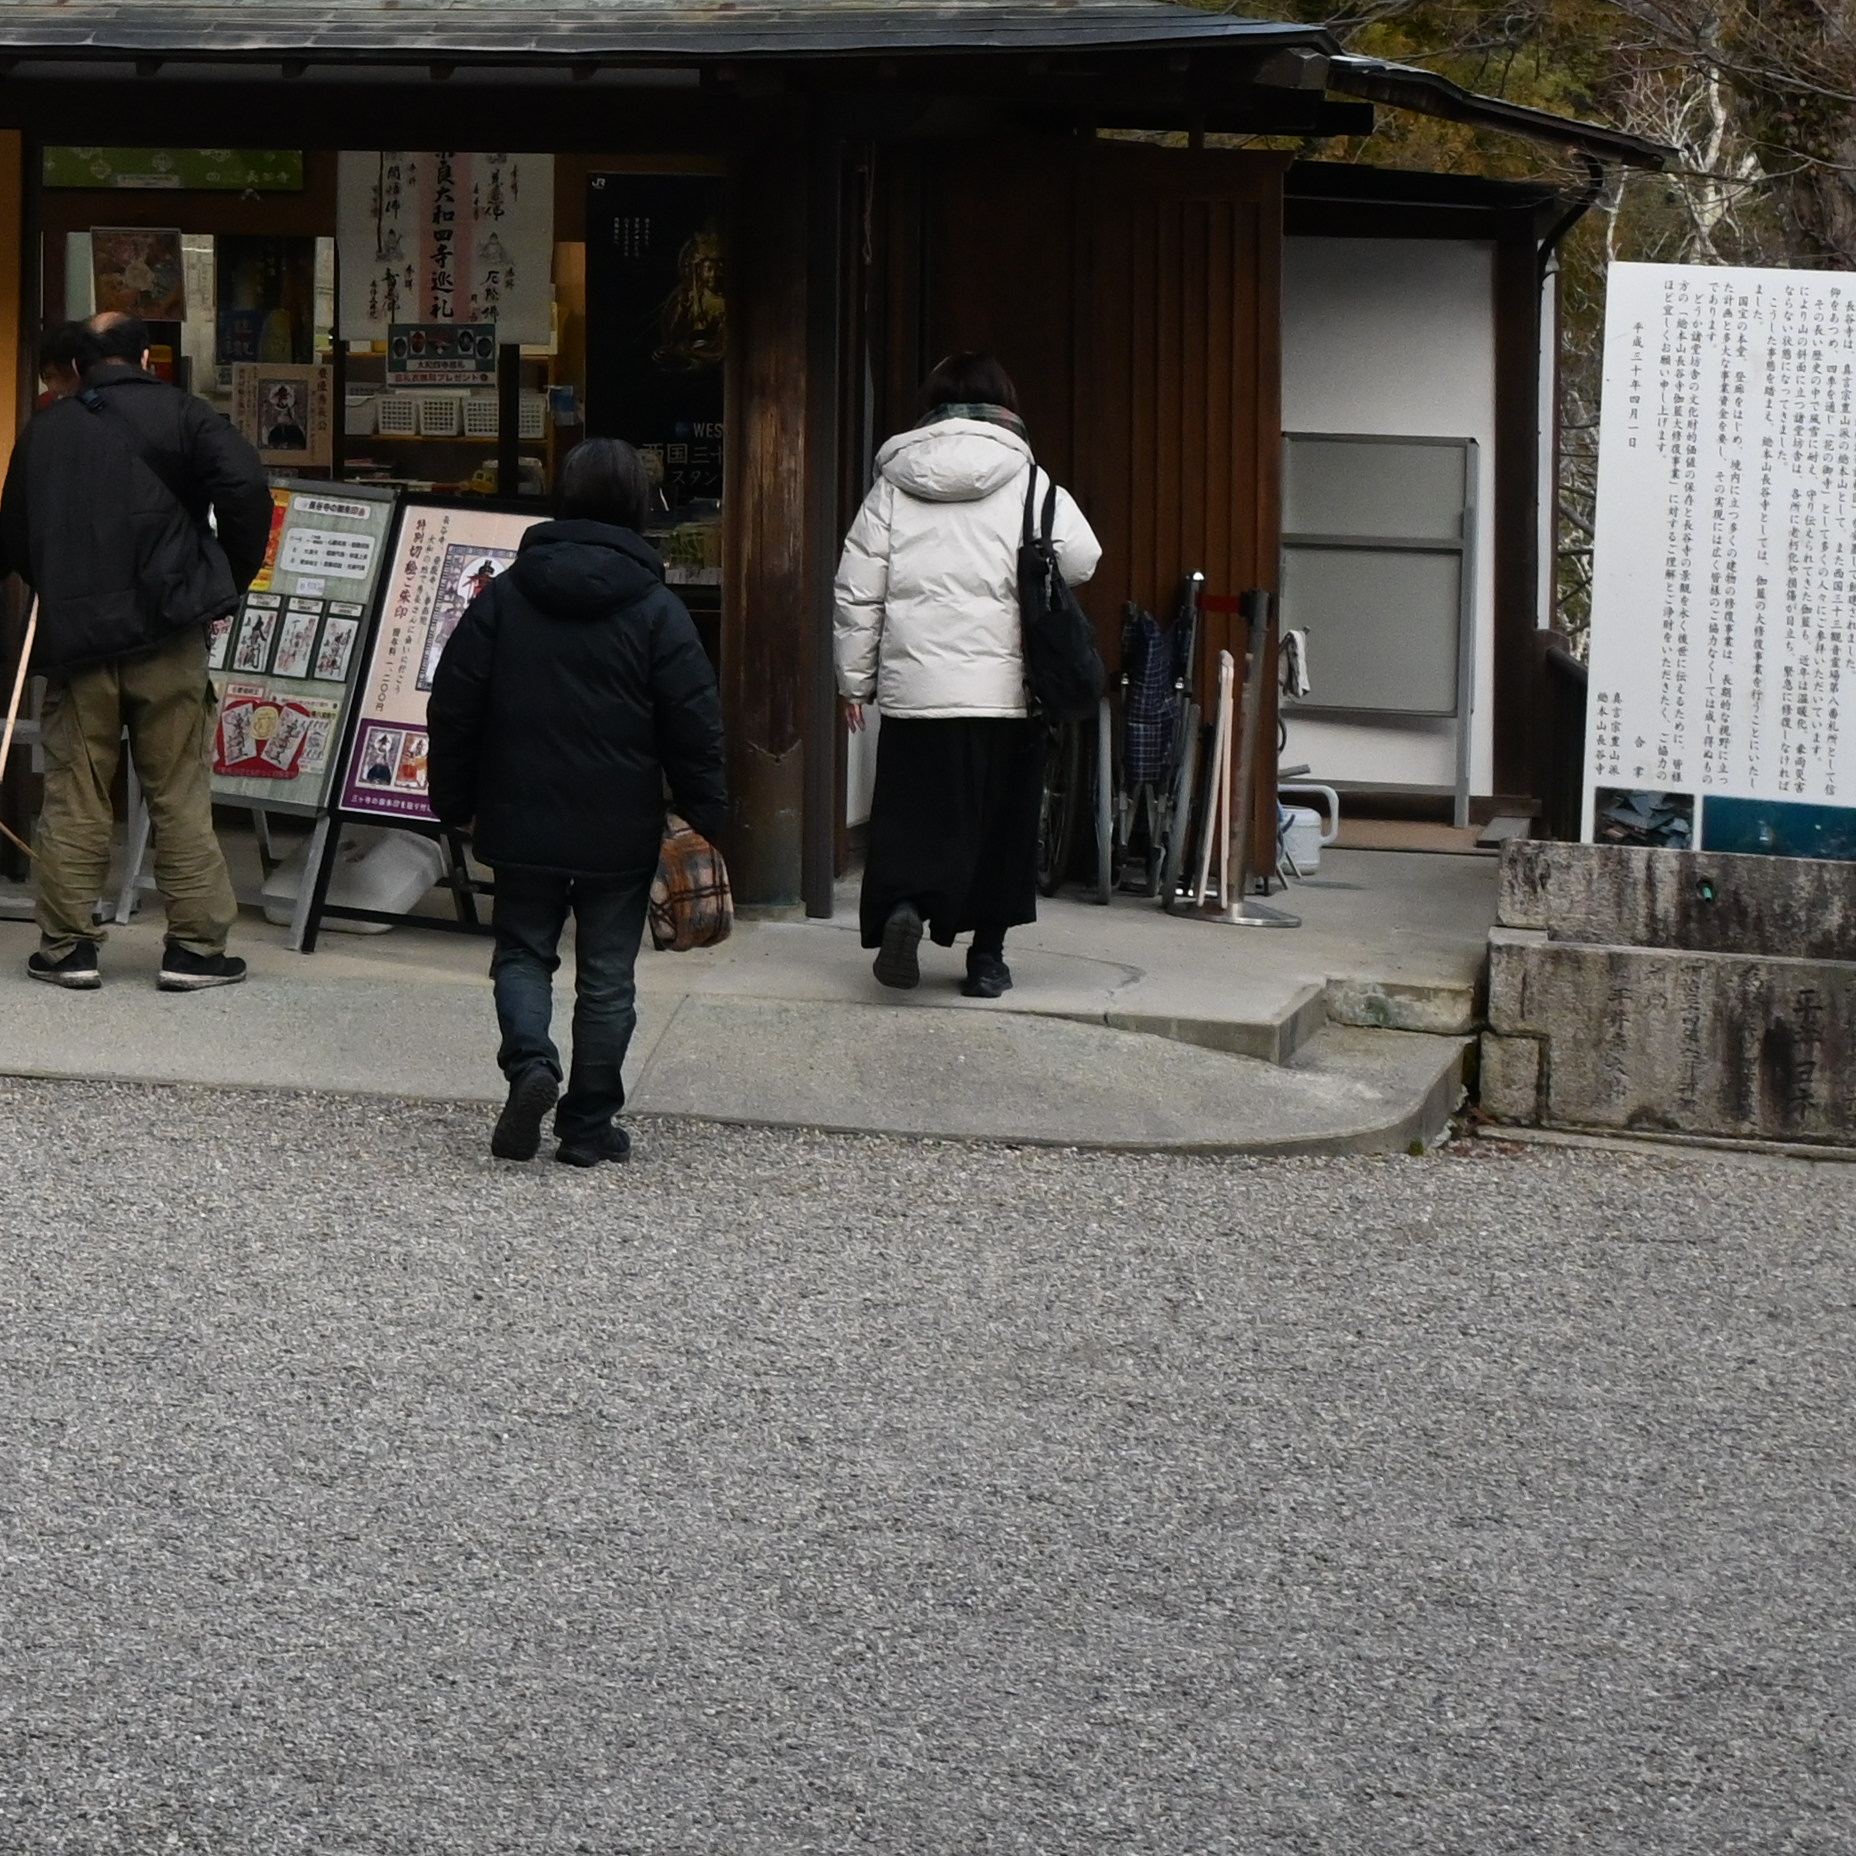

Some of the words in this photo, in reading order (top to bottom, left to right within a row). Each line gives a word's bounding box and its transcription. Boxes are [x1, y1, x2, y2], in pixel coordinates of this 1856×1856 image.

[1627, 322, 1644, 448] 平成三十年四月一日
